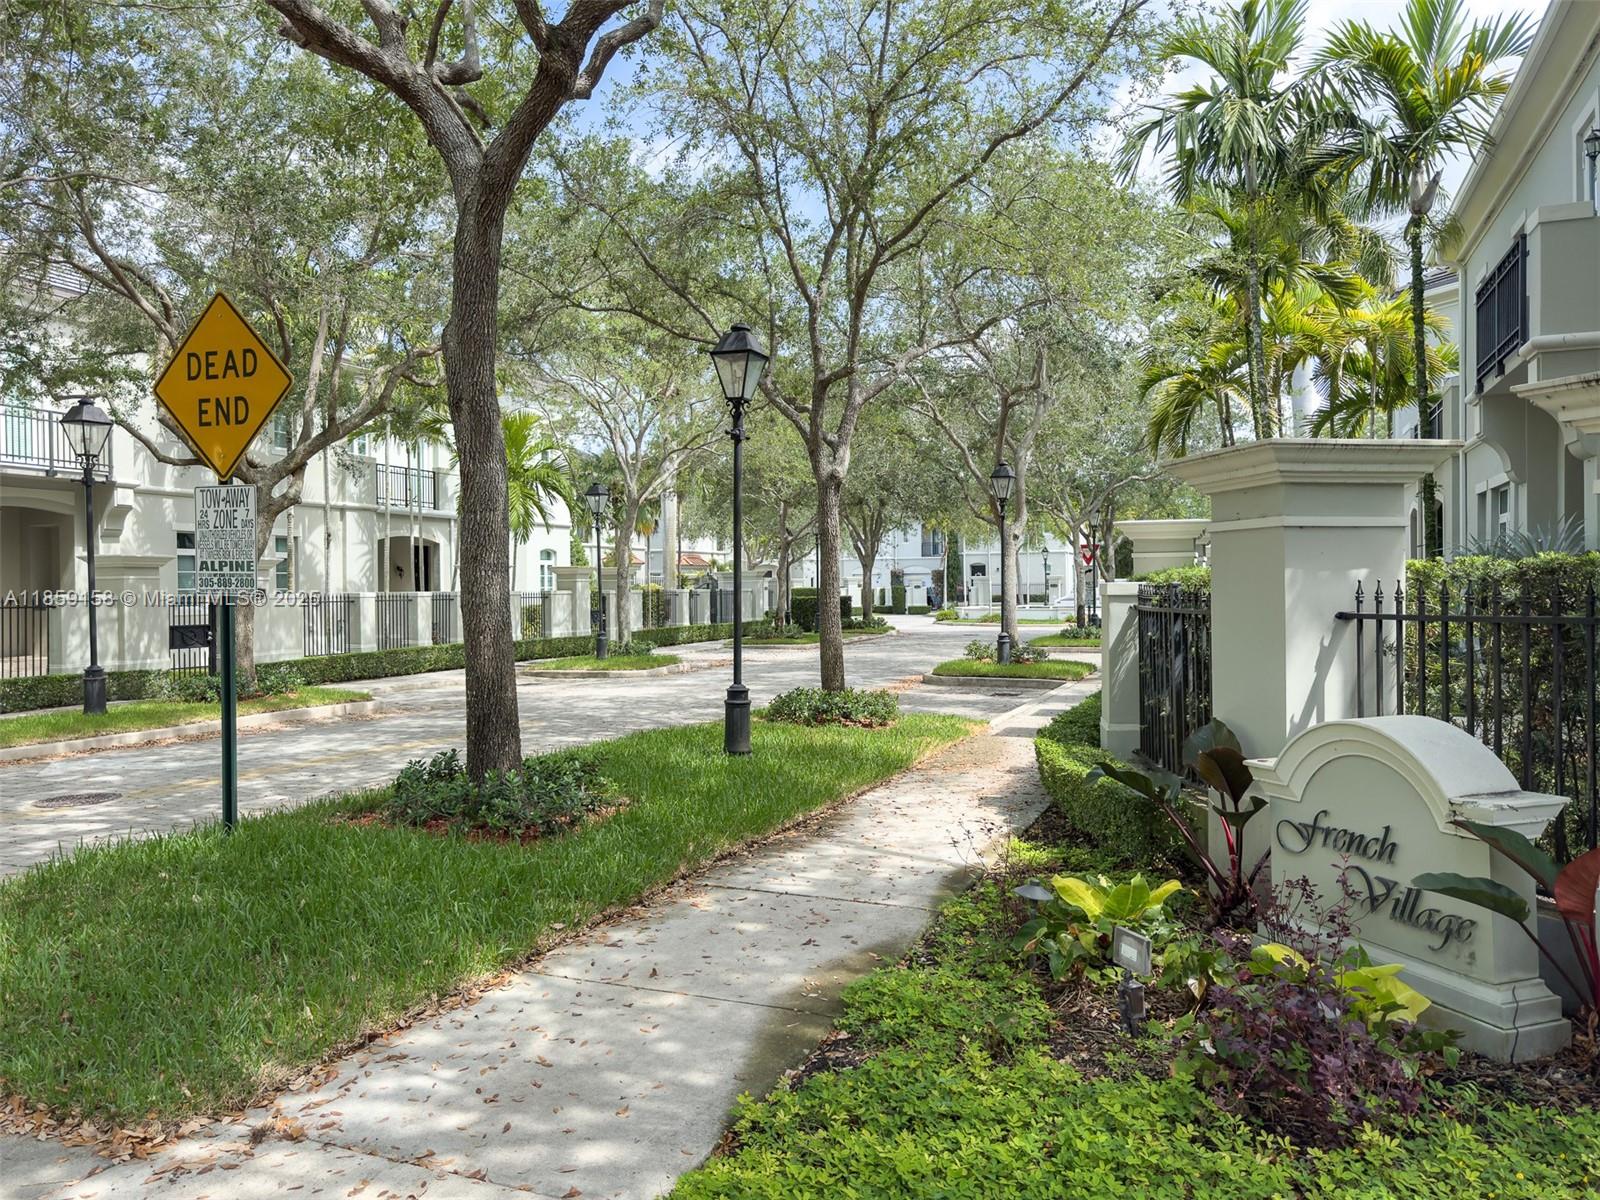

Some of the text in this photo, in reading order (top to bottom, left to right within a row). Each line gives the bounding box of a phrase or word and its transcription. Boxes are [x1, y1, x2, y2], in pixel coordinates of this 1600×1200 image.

[187, 348, 257, 381] DEAD
[198, 396, 249, 427] END
[200, 488, 251, 509] TOW-AWAY
[200, 510, 208, 519] 24
[213, 509, 238, 529] ZONE
[245, 509, 250, 518] 7
[198, 520, 210, 529] HRS
[241, 519, 254, 529] DAYS
[199, 560, 254, 572] ALPINE
[199, 578, 254, 588] 305-889-2800
[1276, 809, 1399, 865] French
[1348, 865, 1477, 951] Village
